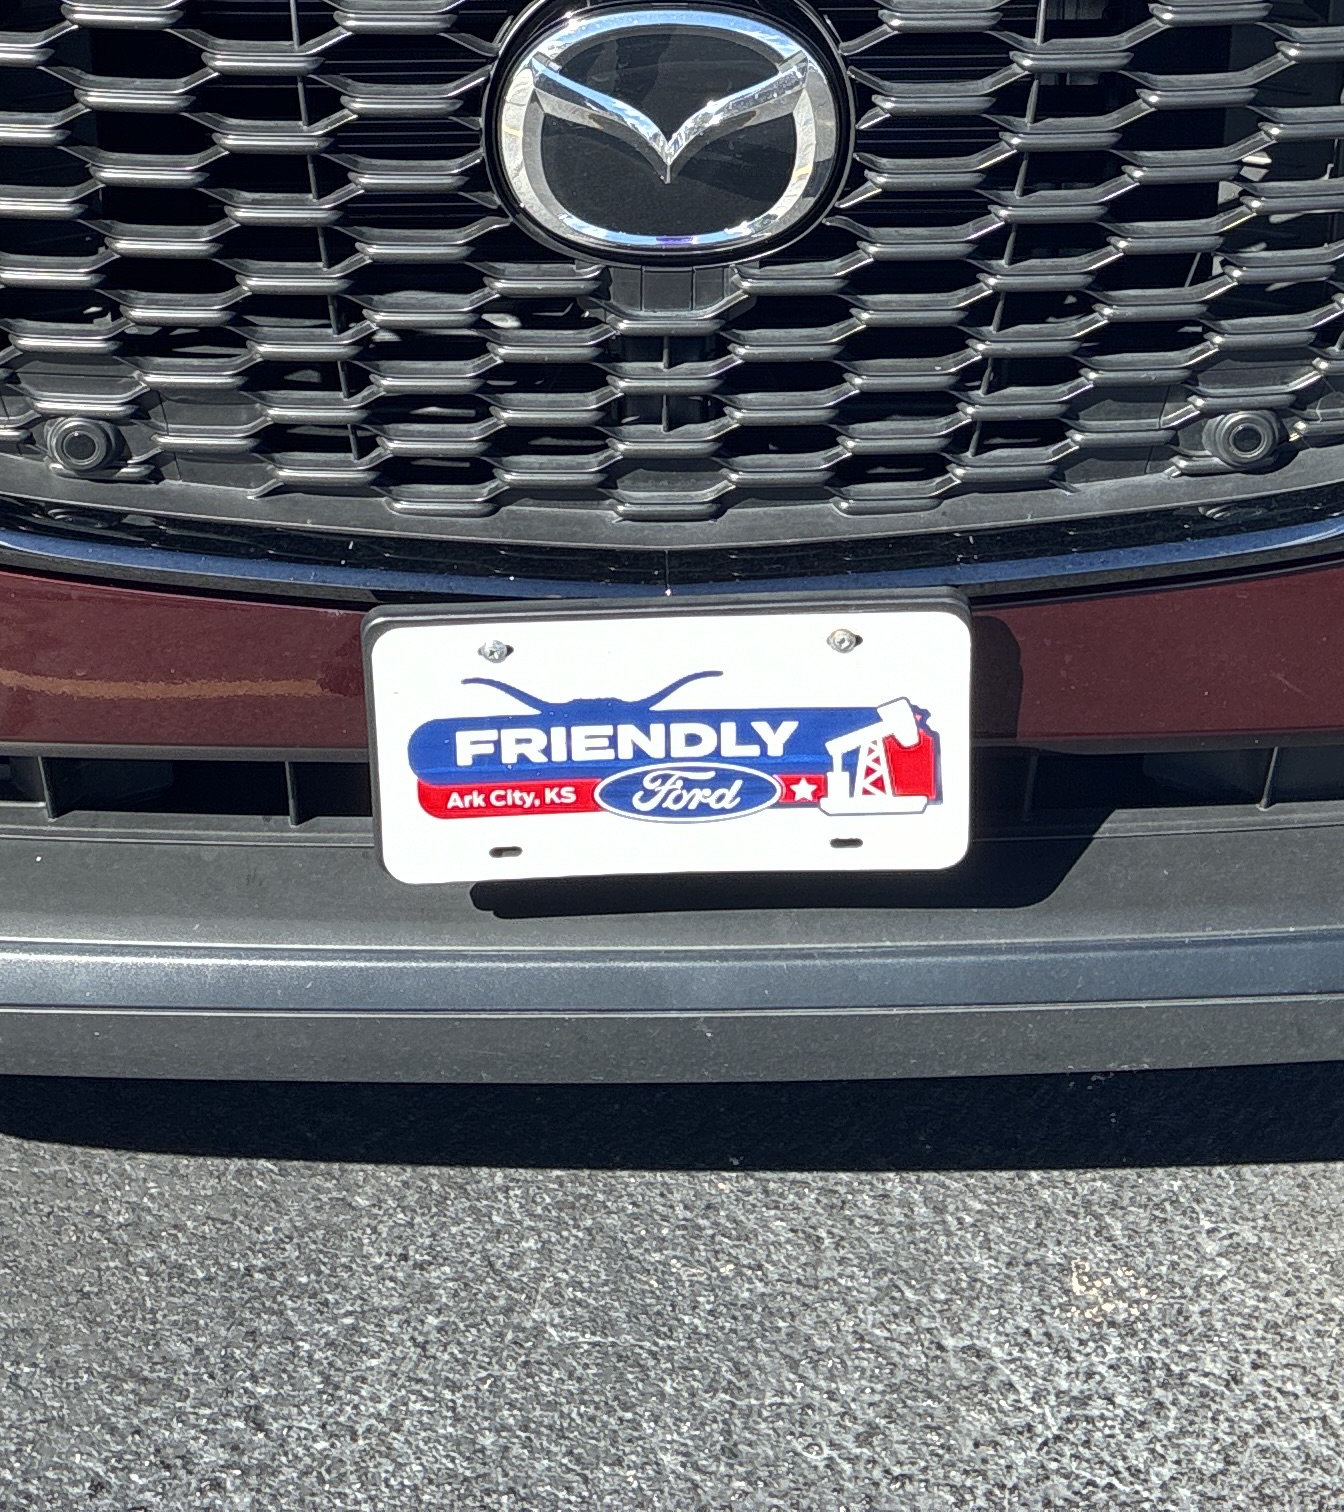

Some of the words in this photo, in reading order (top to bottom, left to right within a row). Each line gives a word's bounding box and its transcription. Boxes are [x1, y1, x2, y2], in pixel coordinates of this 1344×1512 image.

[455, 720, 800, 767] FRIENDLY
[446, 789, 487, 809] Ark
[489, 788, 541, 809] City,
[544, 786, 577, 805] KS
[631, 769, 744, 812] Ford
